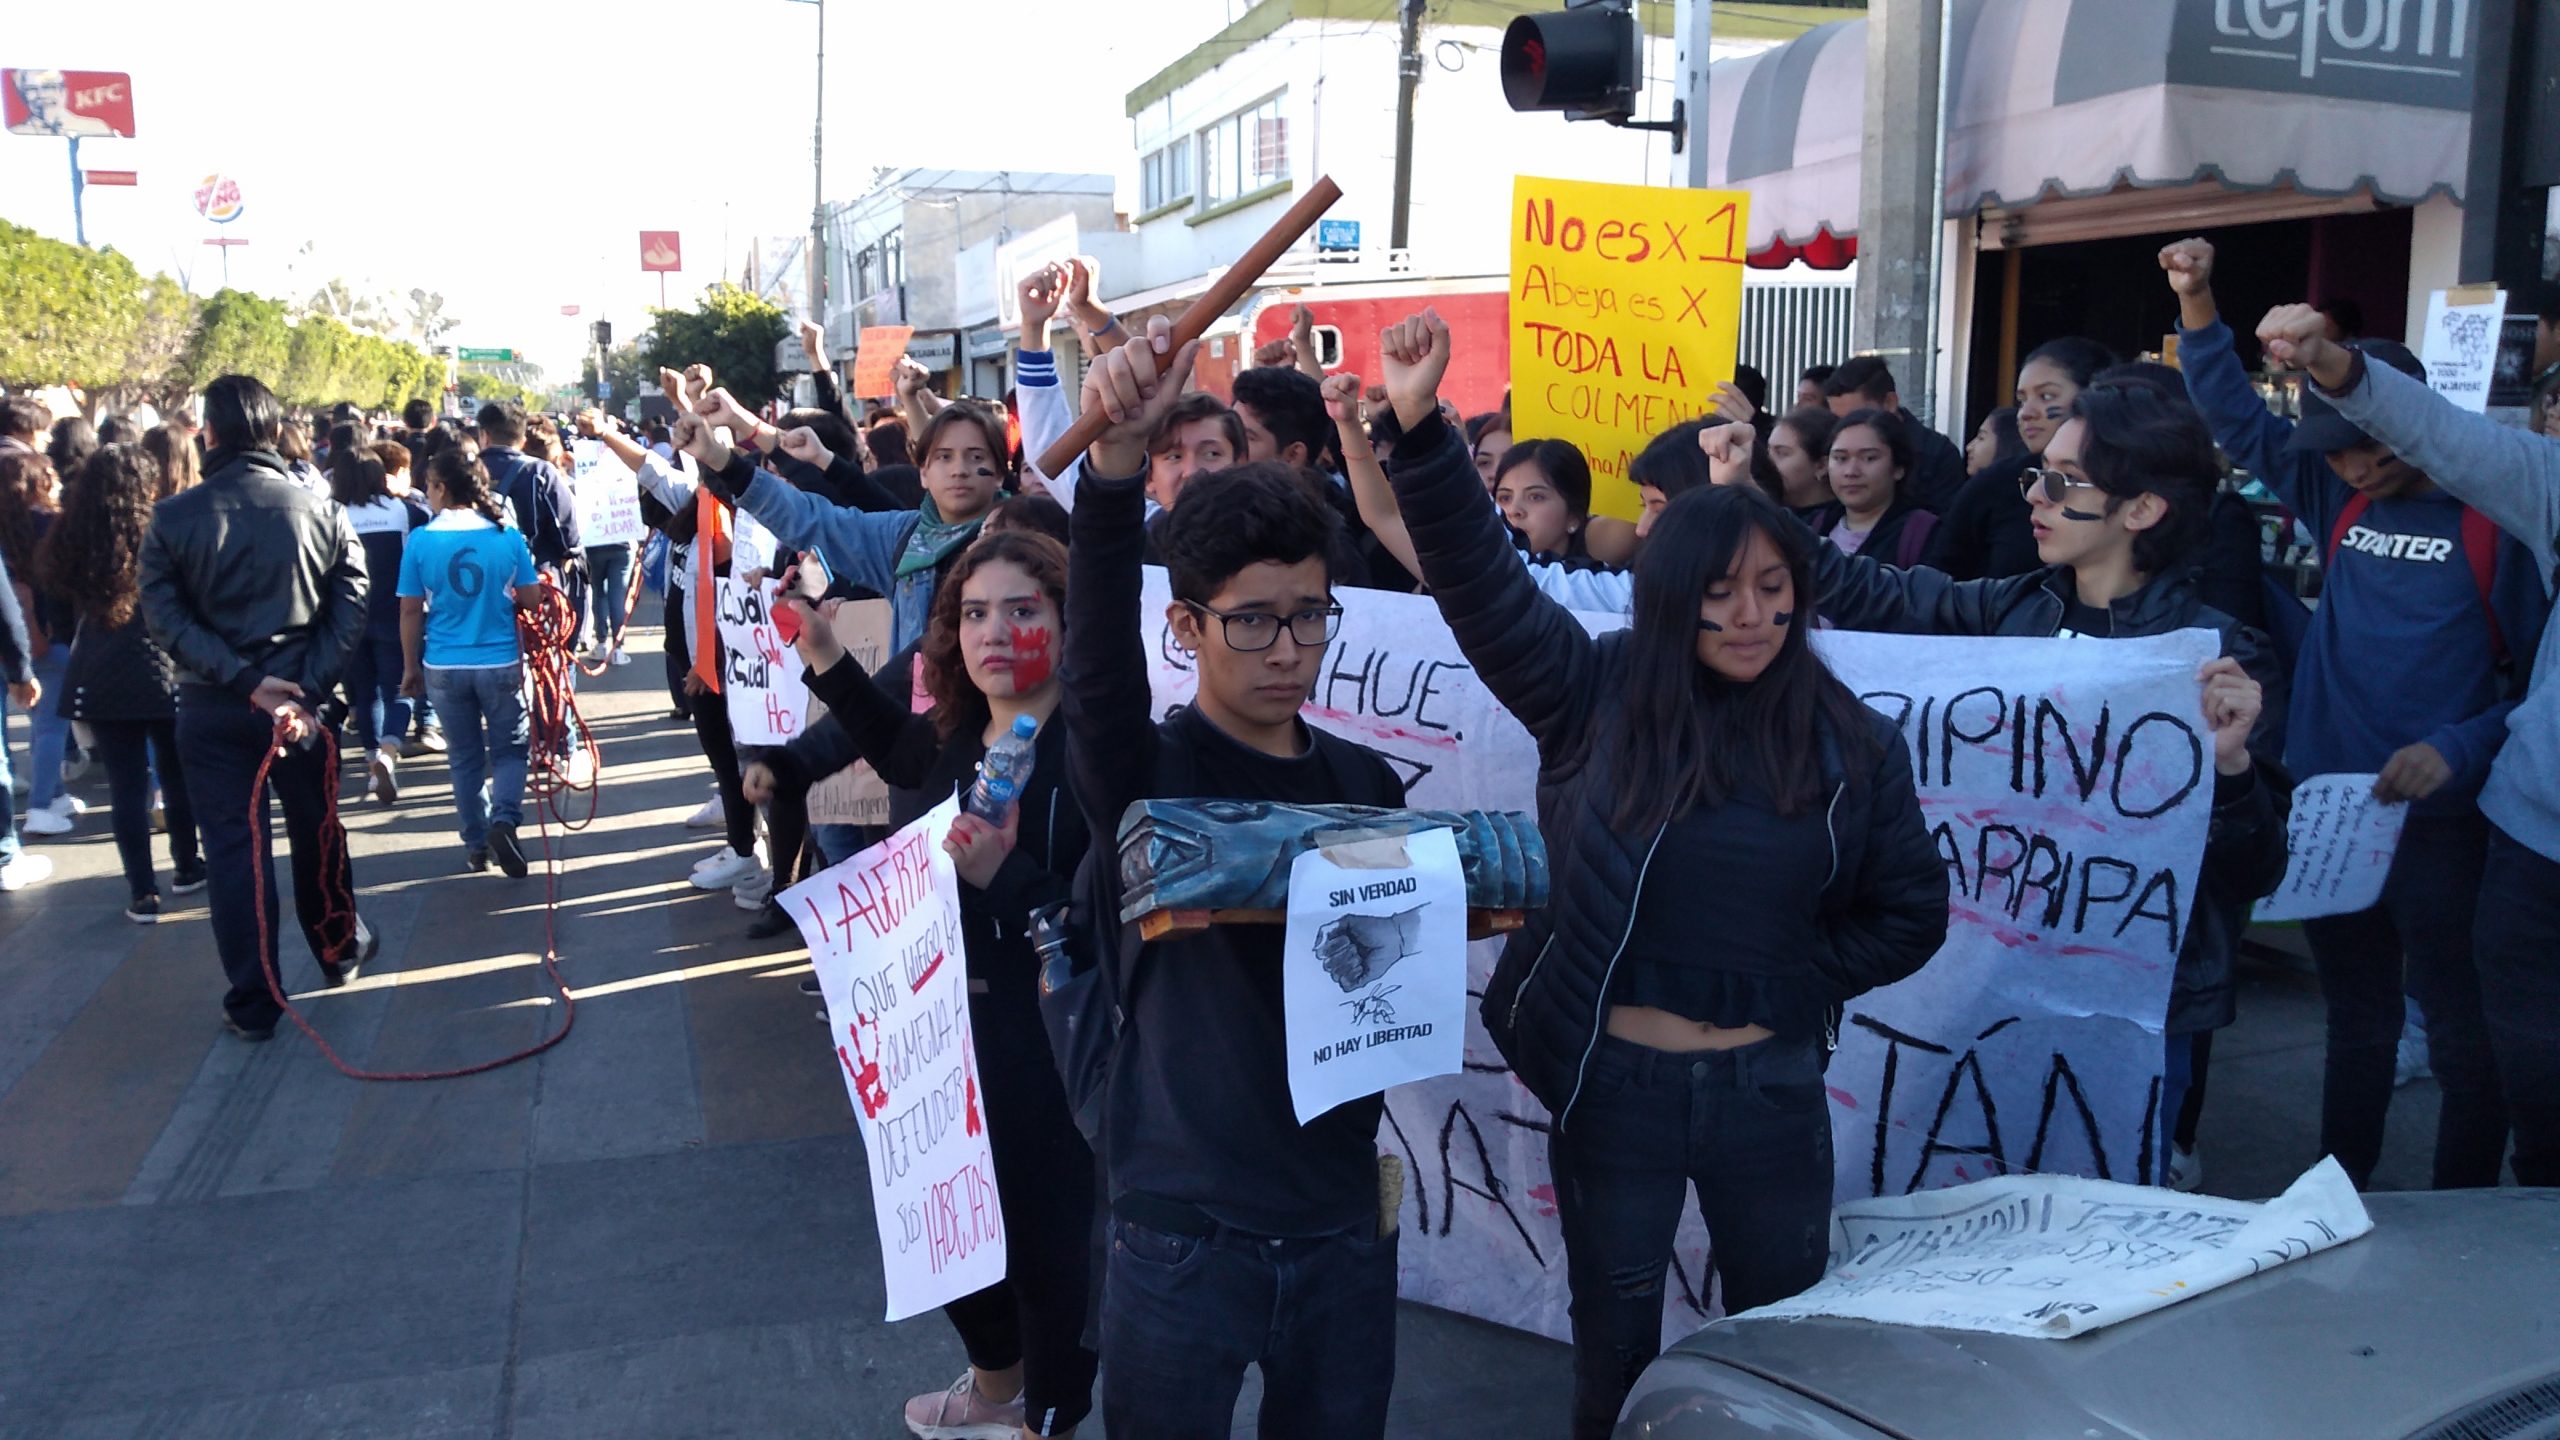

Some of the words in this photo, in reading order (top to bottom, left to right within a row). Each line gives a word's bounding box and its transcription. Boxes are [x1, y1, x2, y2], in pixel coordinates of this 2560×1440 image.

[74, 82, 125, 109] KFC
[1524, 198, 1587, 252] No
[1596, 220, 1651, 263] es
[1699, 202, 1745, 264] 1
[1521, 264, 1619, 319] Abeja
[1628, 293, 1665, 321] es
[1524, 322, 1623, 377] TODA
[1642, 342, 1687, 388] LA
[1546, 382, 1704, 437] COLMEN
[447, 547, 486, 598] 6
[1328, 887, 1356, 908] SIN
[1358, 876, 1418, 903] VERDAD
[852, 961, 898, 1025] QUE
[1312, 1045, 1332, 1066] NO
[1335, 1035, 1363, 1056] HAY
[1366, 1022, 1433, 1049] LIBERTAD
[877, 1065, 966, 1188] DEFENDER
